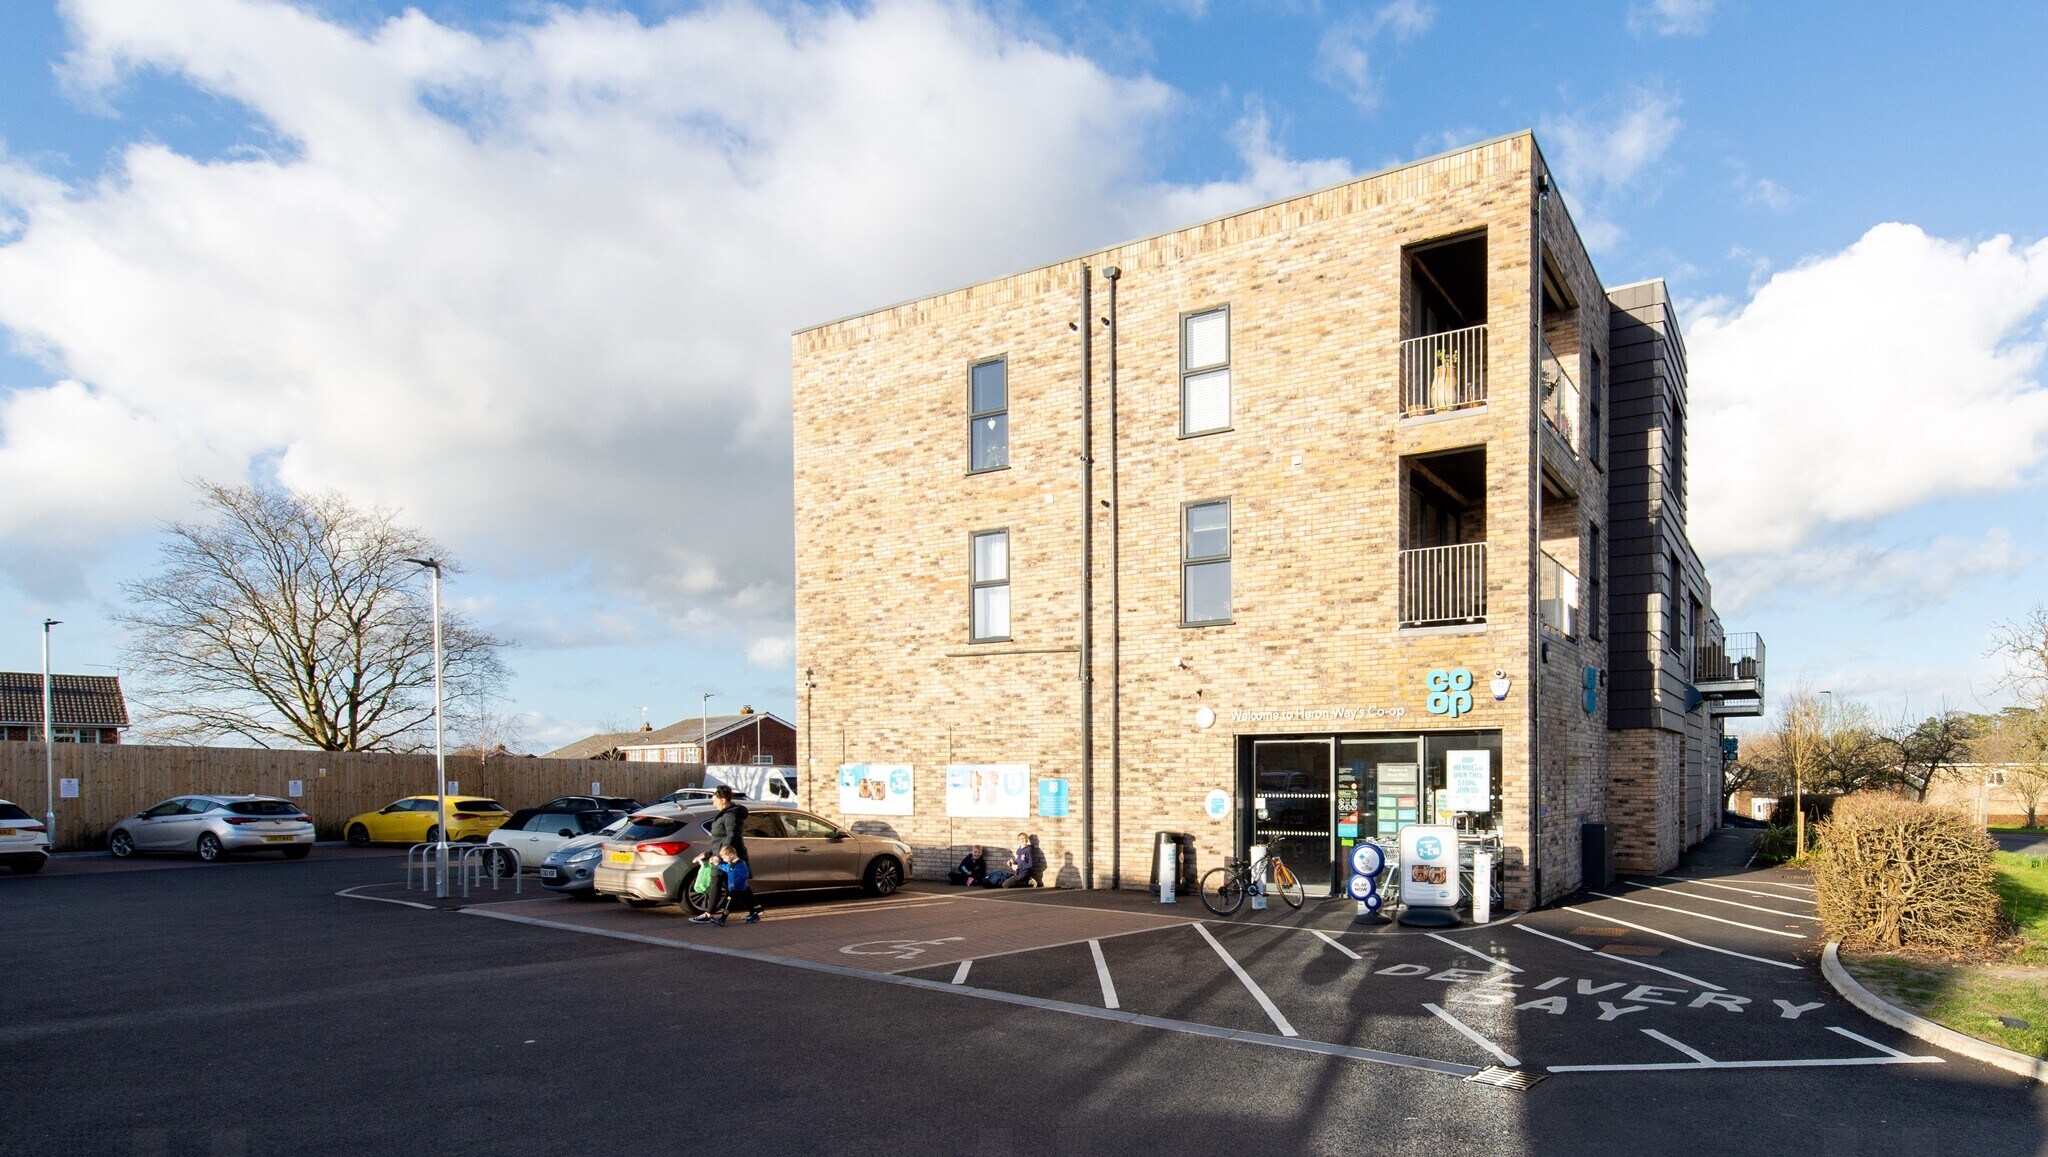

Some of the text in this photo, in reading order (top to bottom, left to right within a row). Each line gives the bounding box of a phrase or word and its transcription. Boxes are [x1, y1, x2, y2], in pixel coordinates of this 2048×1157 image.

[1229, 710, 1280, 721] Welcome
[1282, 711, 1294, 720] to
[1296, 708, 1329, 720] Heron
[1332, 707, 1365, 721] Way's
[1374, 964, 1826, 1019] DELIVERY
[1449, 988, 1649, 1021] BAY
